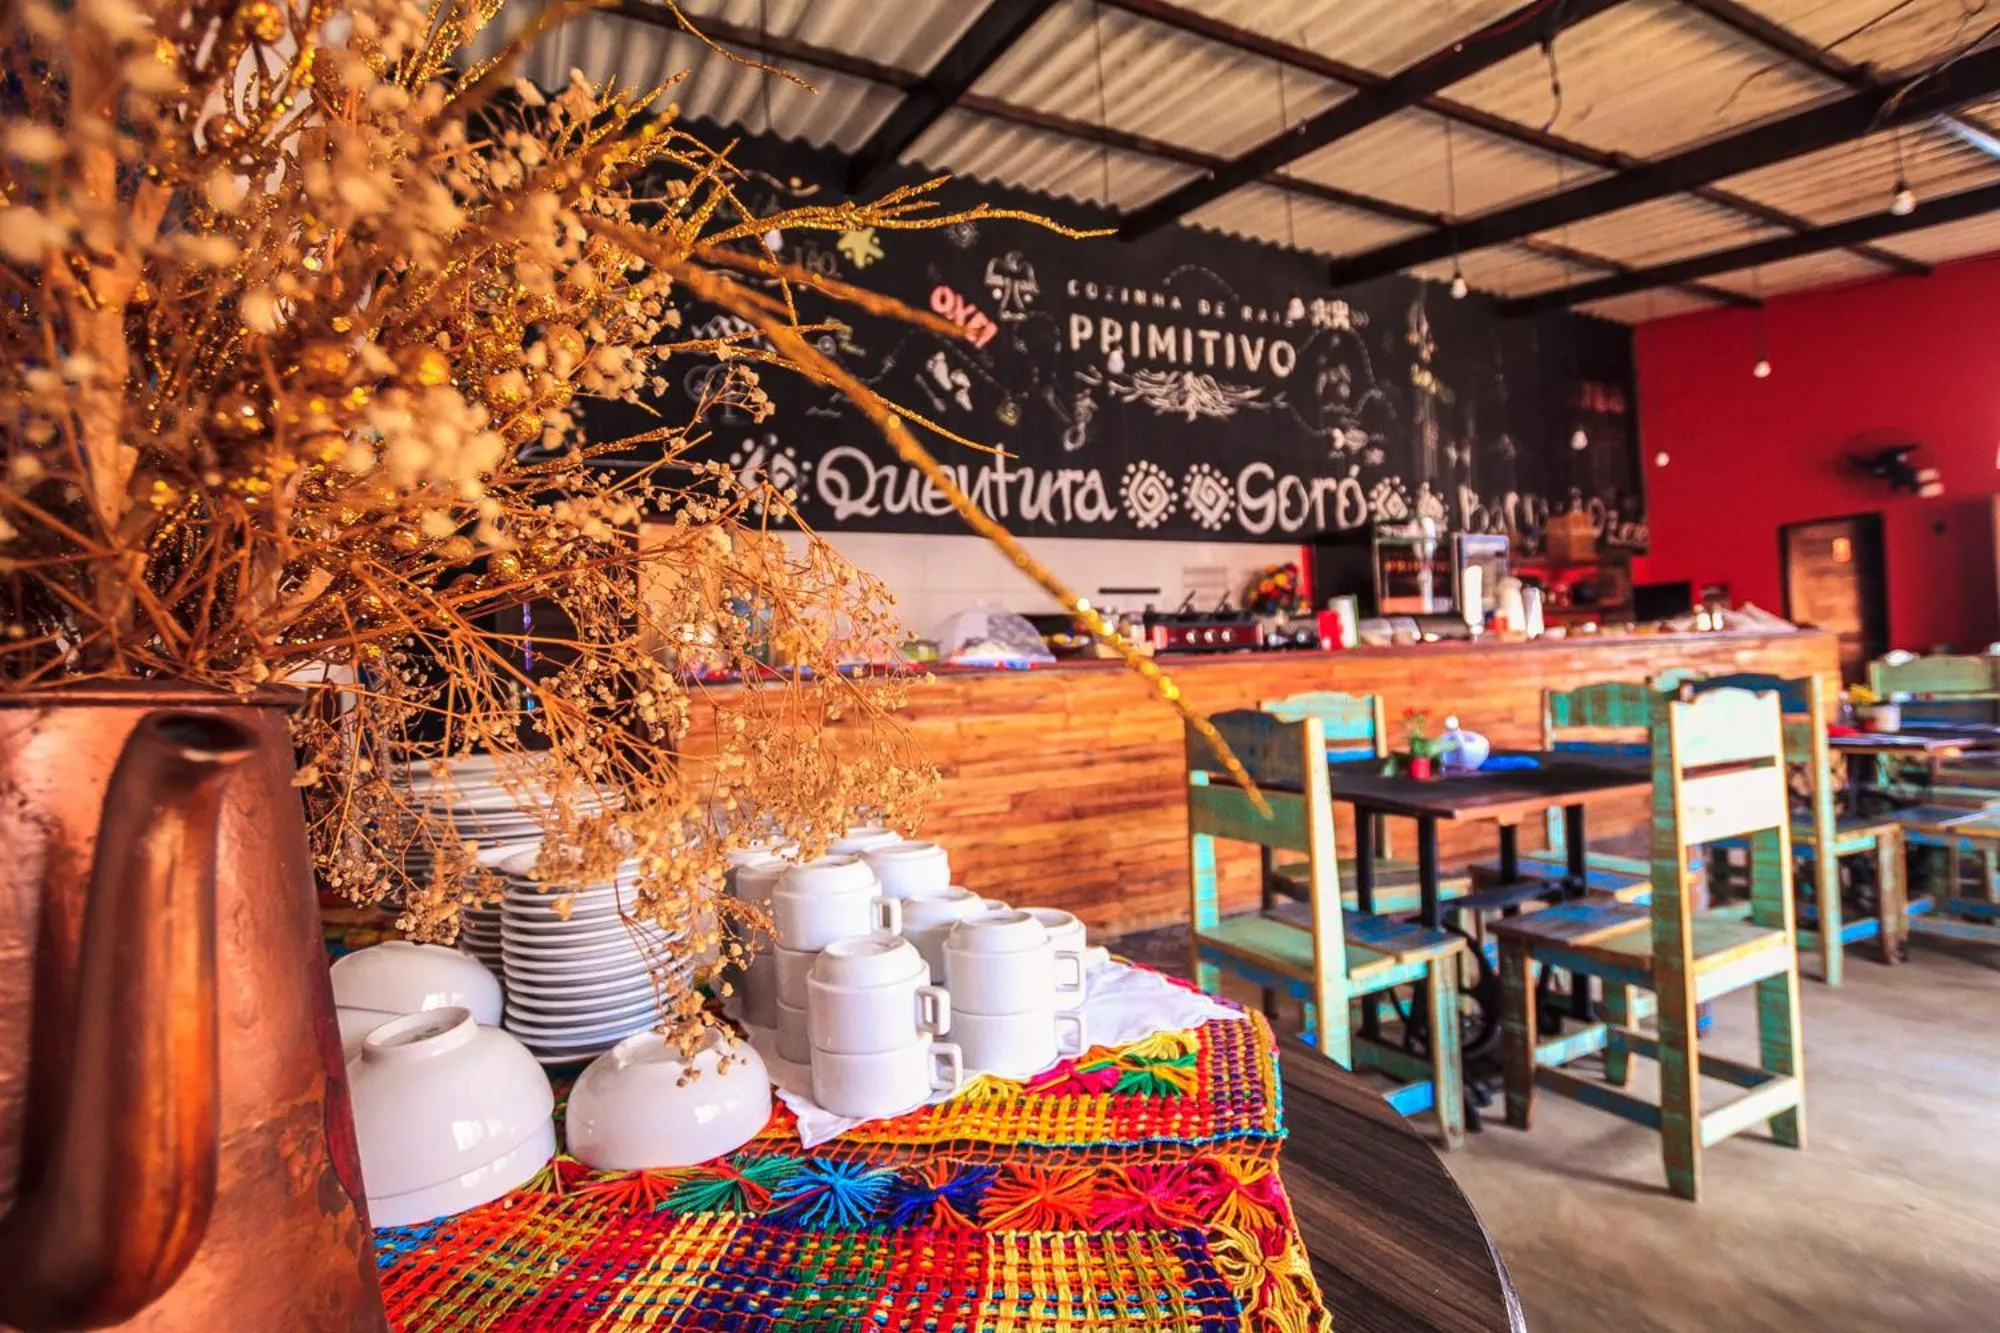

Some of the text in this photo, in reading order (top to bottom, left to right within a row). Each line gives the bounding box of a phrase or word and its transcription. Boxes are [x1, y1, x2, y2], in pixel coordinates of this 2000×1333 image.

[1067, 278, 1182, 311] COZINHA
[1198, 298, 1227, 319] DE
[1068, 313, 1297, 379] PRIMITIVO
[816, 443, 1118, 525] Quentura
[1237, 463, 1368, 535] Goró
